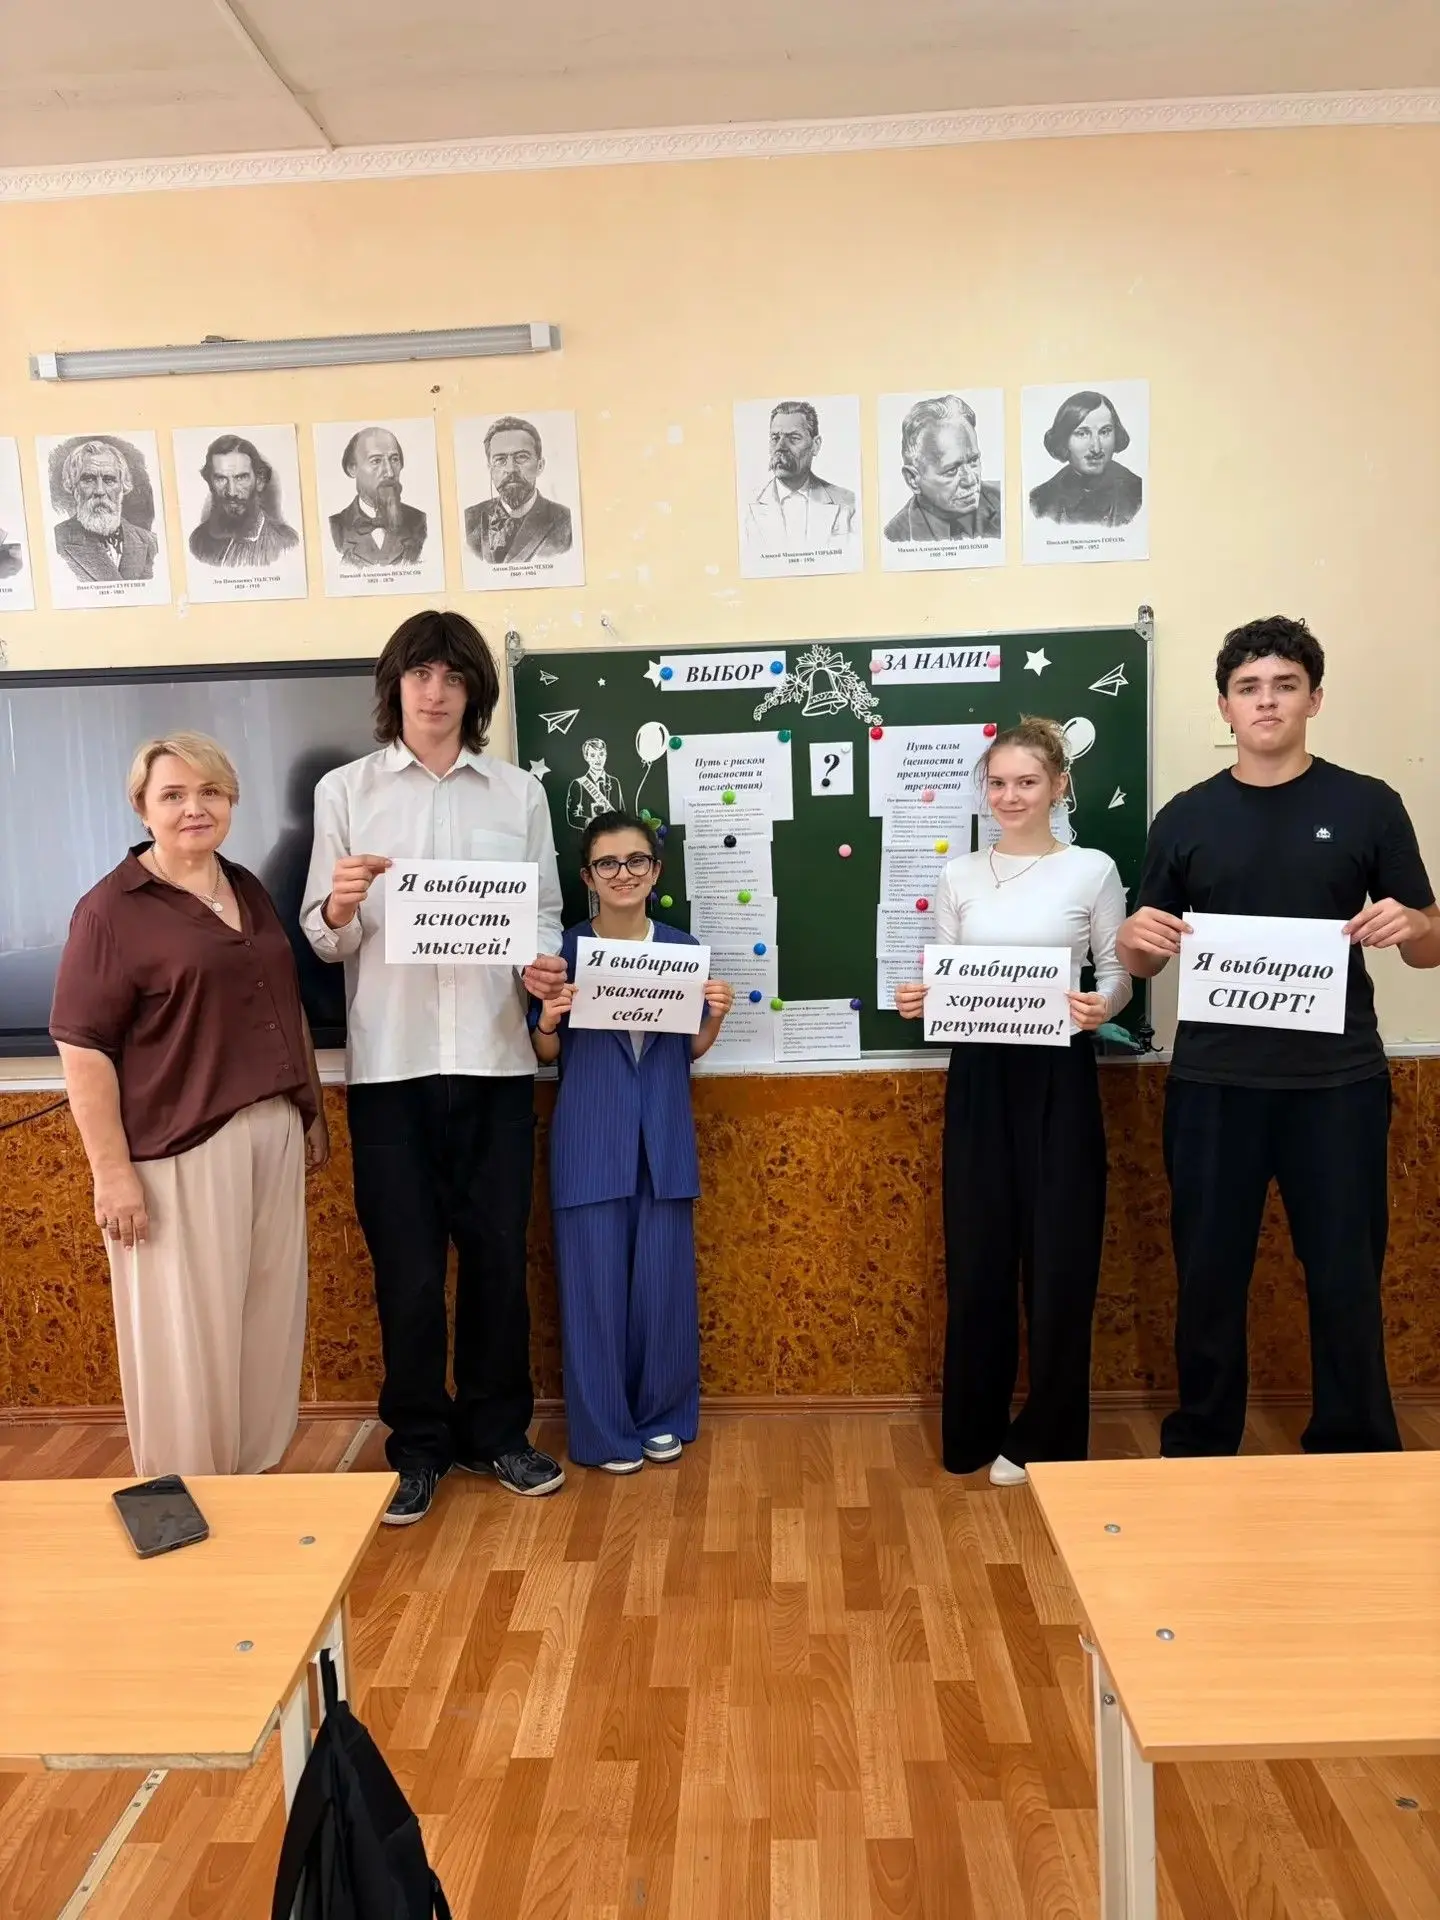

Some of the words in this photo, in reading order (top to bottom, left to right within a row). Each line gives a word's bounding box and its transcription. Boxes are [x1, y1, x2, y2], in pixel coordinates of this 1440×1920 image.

[881, 654, 907, 670] ЗА
[913, 651, 990, 670] НАМИ!
[686, 663, 764, 682] ВЫБОР
[906, 742, 933, 753] Путь
[695, 758, 721, 768] Путь
[730, 758, 765, 767] риском
[822, 754, 840, 787] ?
[903, 757, 954, 766] (ценности
[698, 770, 754, 780] (опасности
[897, 770, 969, 780] преимущества
[699, 782, 763, 791] последствия)
[904, 782, 961, 792] трезвости)
[398, 873, 419, 892] Я
[424, 875, 527, 899] выбираю
[413, 912, 511, 927] ясность
[412, 937, 511, 956] мыслей!
[587, 950, 607, 967] Я
[610, 954, 699, 976] выбираю
[935, 958, 954, 976] Я
[959, 960, 1058, 982] выбираю
[1192, 952, 1215, 971] Я
[1220, 956, 1334, 982] выбираю
[592, 985, 685, 1001] уважать
[1209, 987, 1316, 1014] СПОРТ!
[946, 994, 1046, 1013] хорошую
[612, 1007, 663, 1022] себя!
[929, 1019, 1064, 1038] репутацию!
